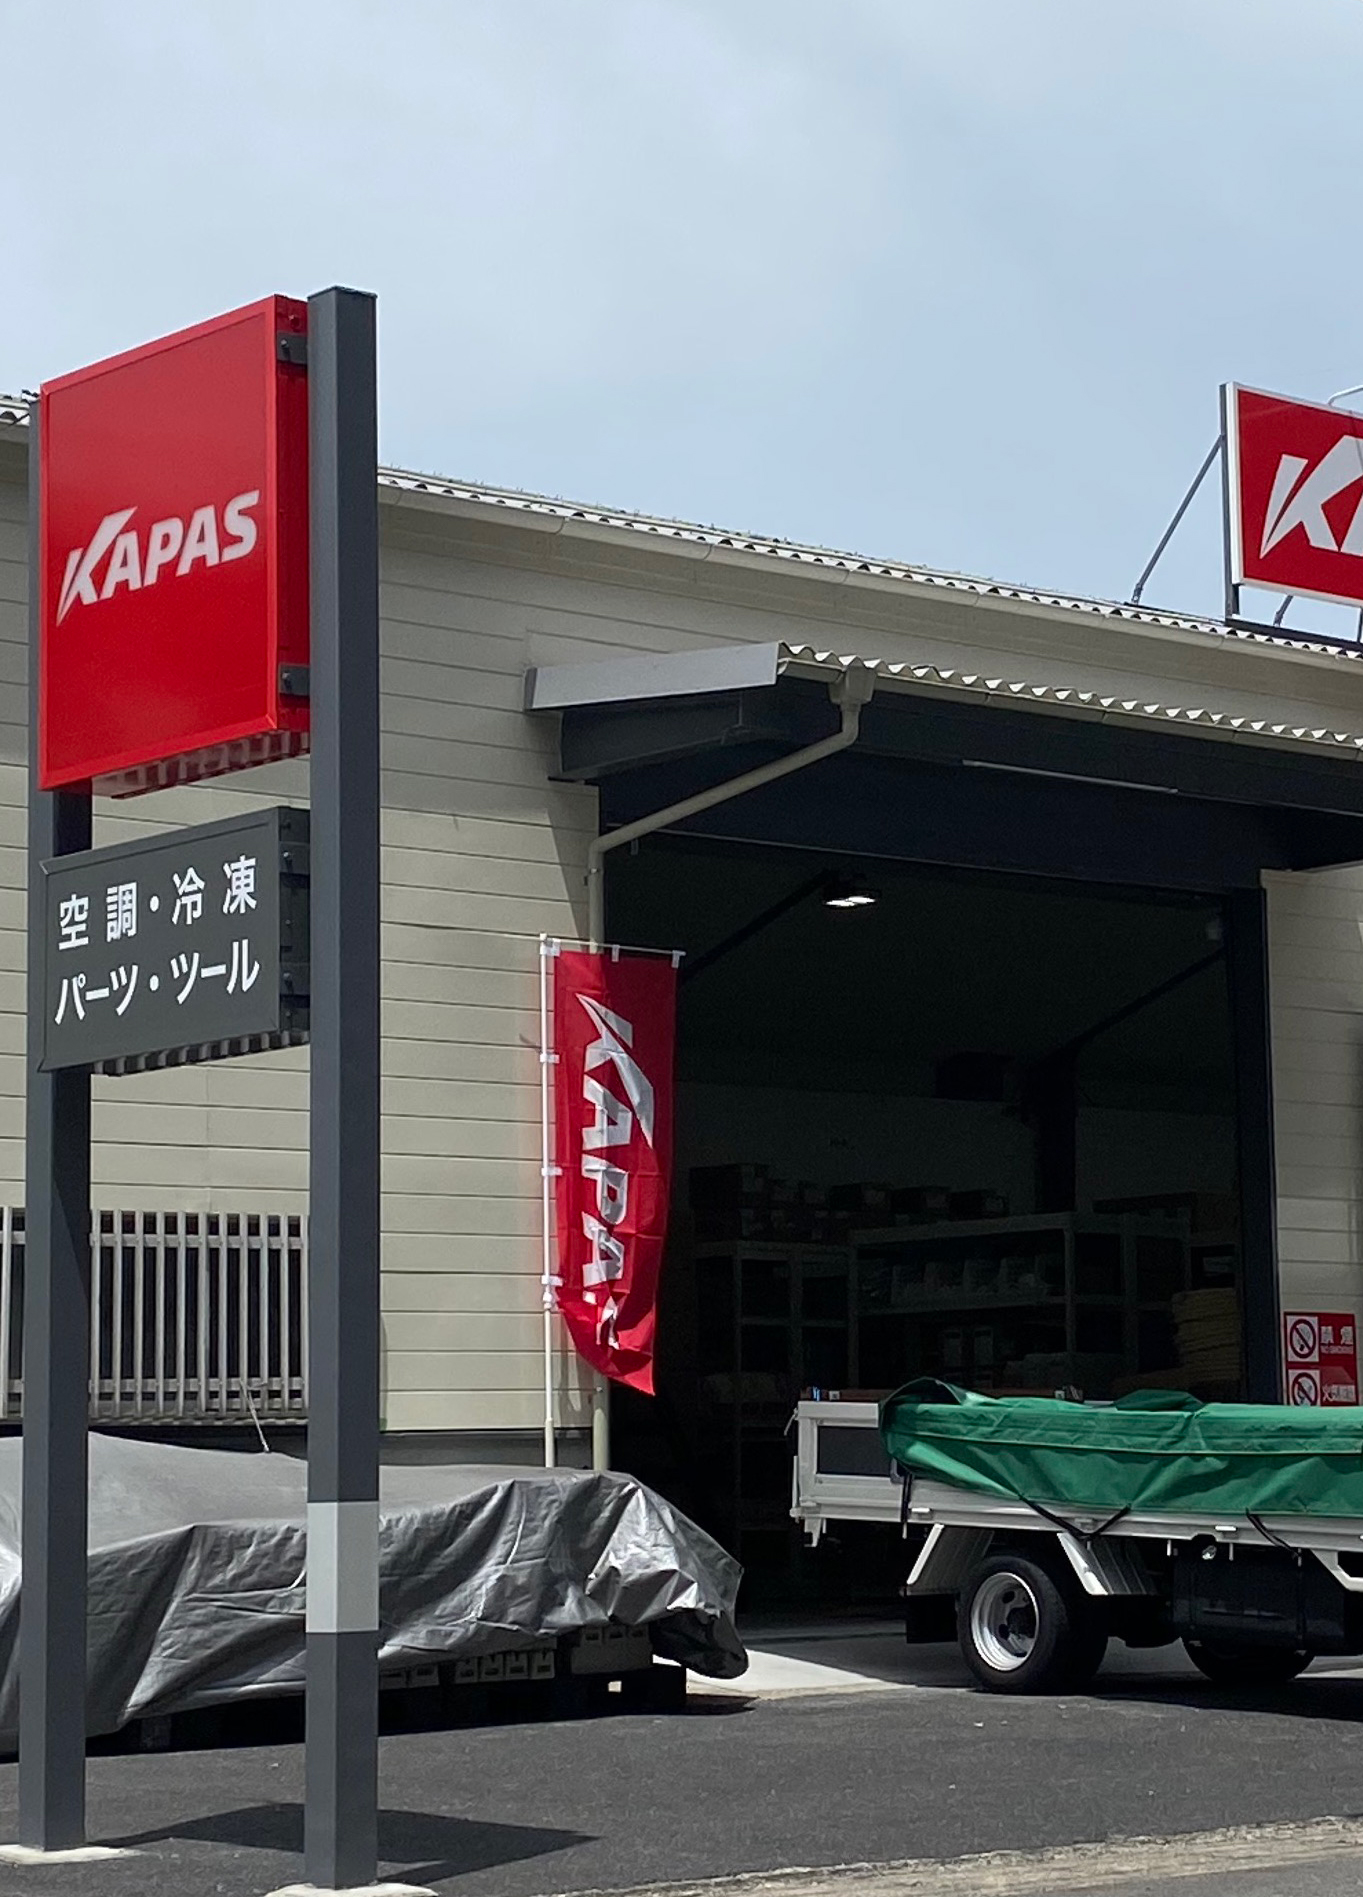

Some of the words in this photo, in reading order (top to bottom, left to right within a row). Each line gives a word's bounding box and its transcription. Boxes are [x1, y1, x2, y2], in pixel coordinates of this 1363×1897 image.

[56, 489, 260, 627] KAPAS
[58, 854, 258, 951] 空調・冷凍
[55, 938, 261, 1025] パーツ・ツール
